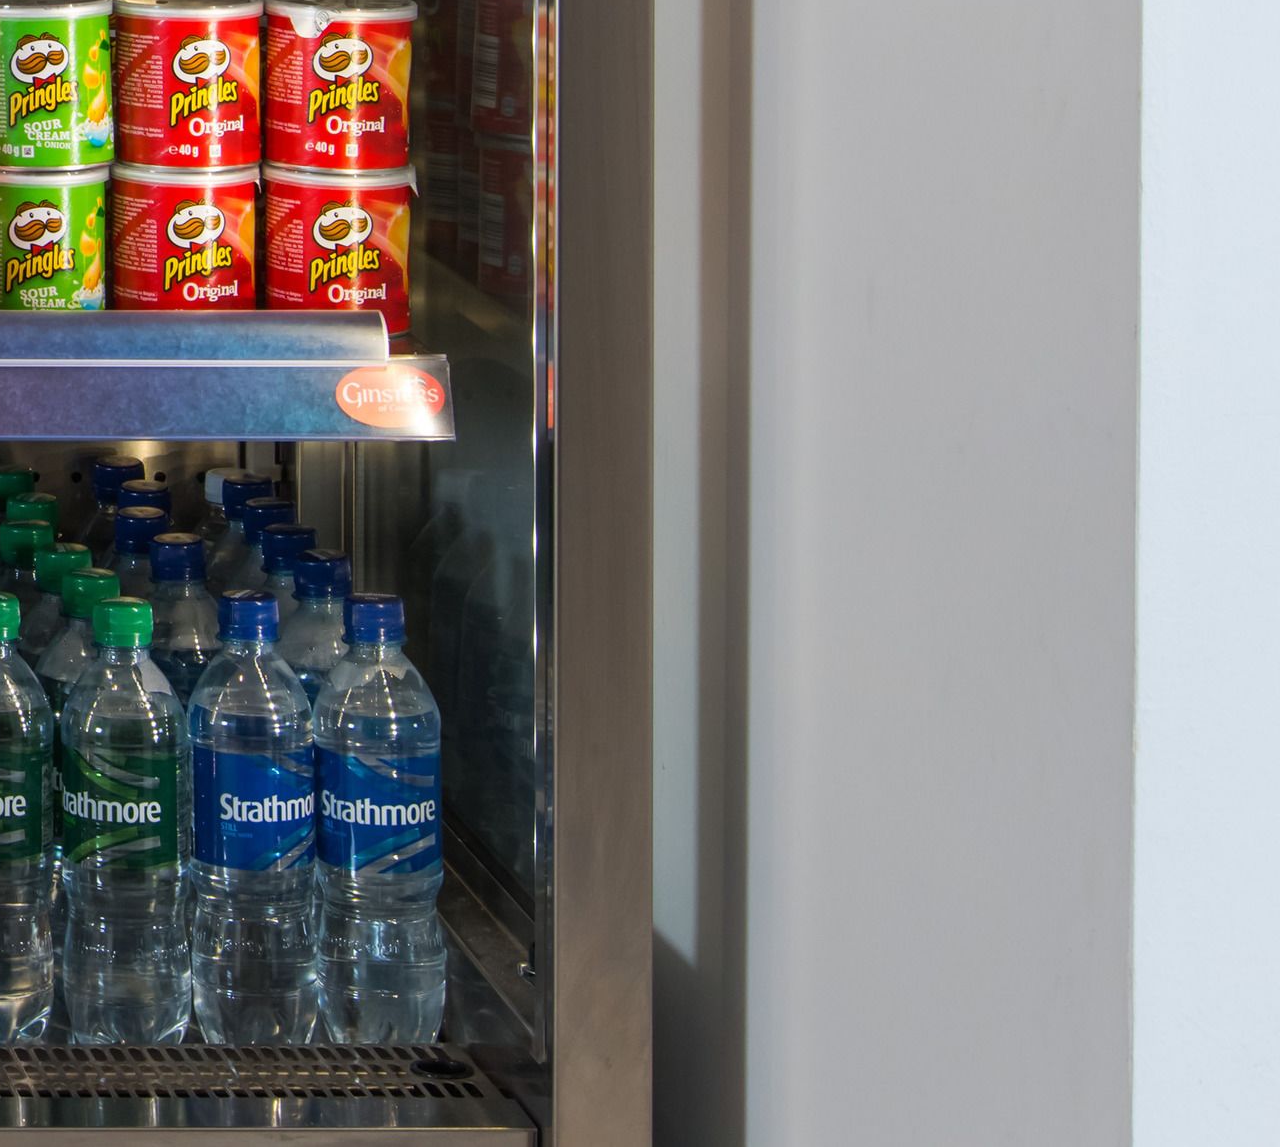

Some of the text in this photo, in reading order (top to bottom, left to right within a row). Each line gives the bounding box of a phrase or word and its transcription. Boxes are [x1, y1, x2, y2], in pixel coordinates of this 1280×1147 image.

[9, 76, 79, 128] Pringles
[169, 76, 238, 127] Pringles
[308, 77, 380, 125] Pringles
[24, 119, 63, 133] SOUR
[28, 130, 70, 141] CREAM
[188, 116, 244, 138] Original
[44, 140, 71, 150] ONION
[322, 790, 436, 826] Strathmore
